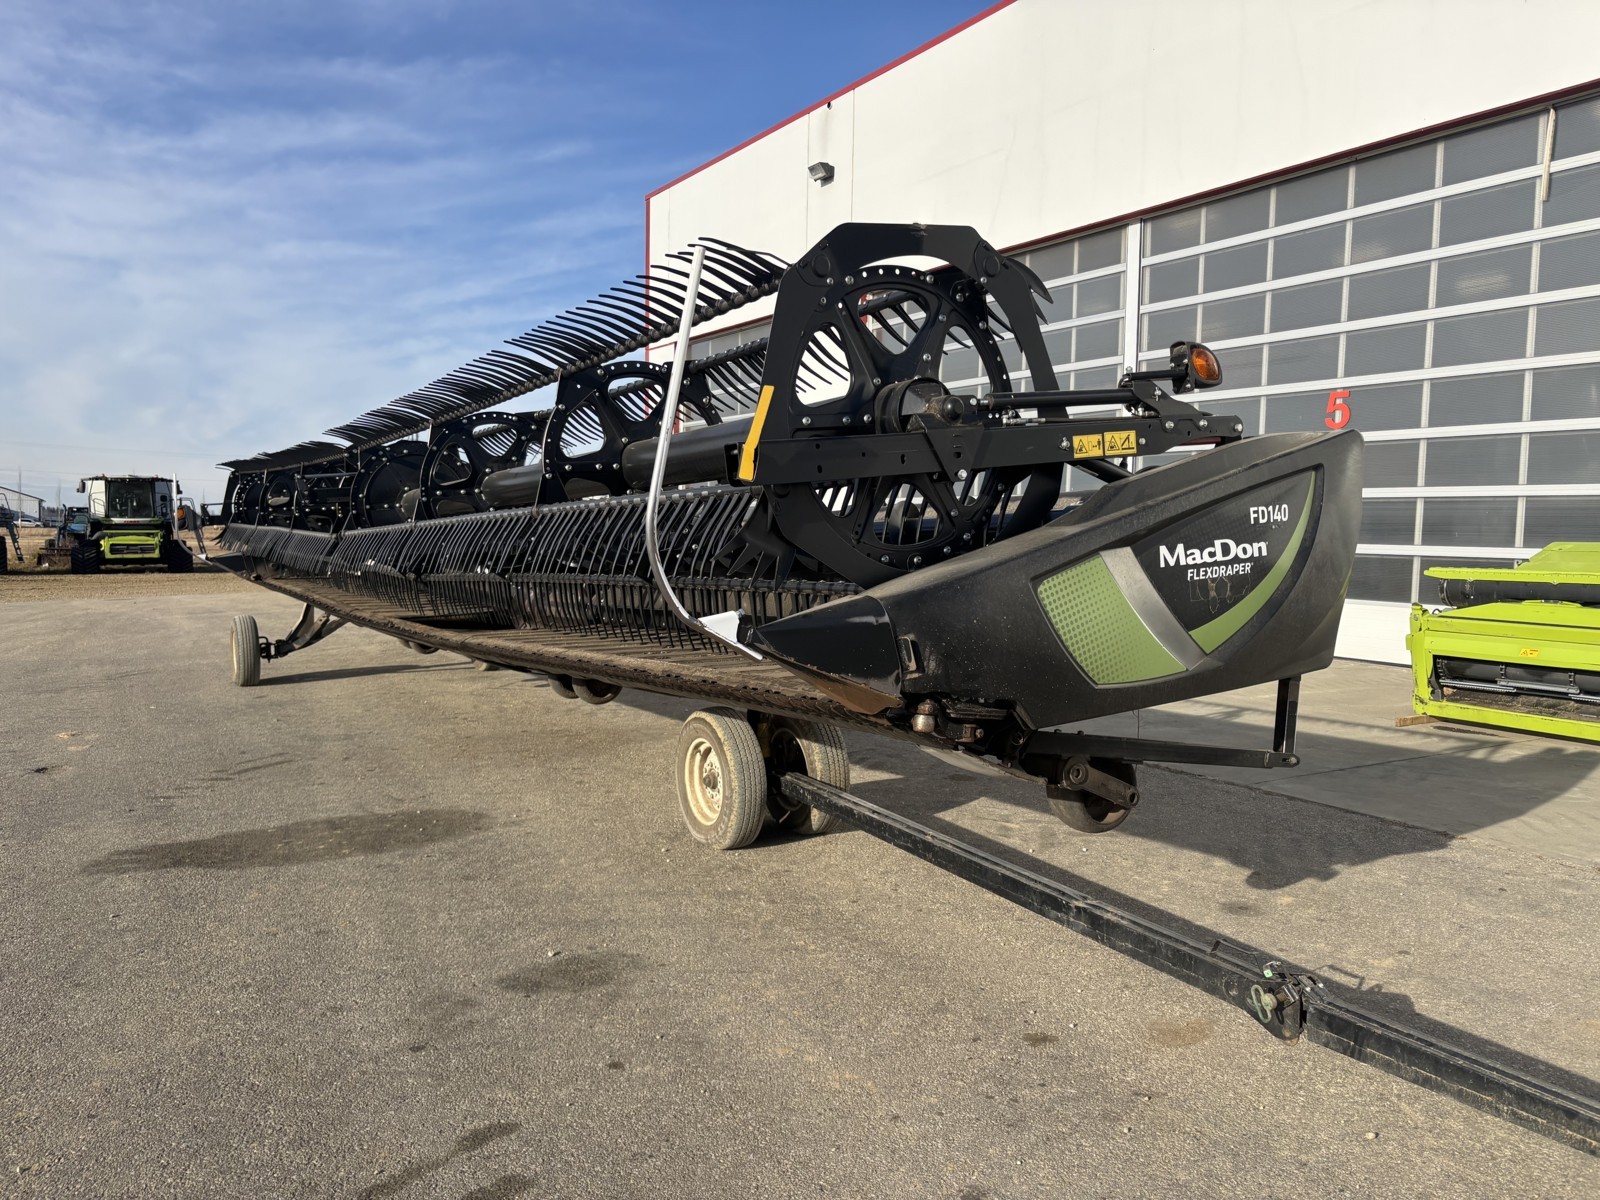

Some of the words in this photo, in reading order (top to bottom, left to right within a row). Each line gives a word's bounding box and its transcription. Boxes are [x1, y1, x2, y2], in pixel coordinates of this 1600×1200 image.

[1325, 390, 1350, 430] 5
[1250, 504, 1289, 525] FD140
[1159, 539, 1268, 568] MacDon
[1187, 563, 1253, 581] FLEXDRAPER
